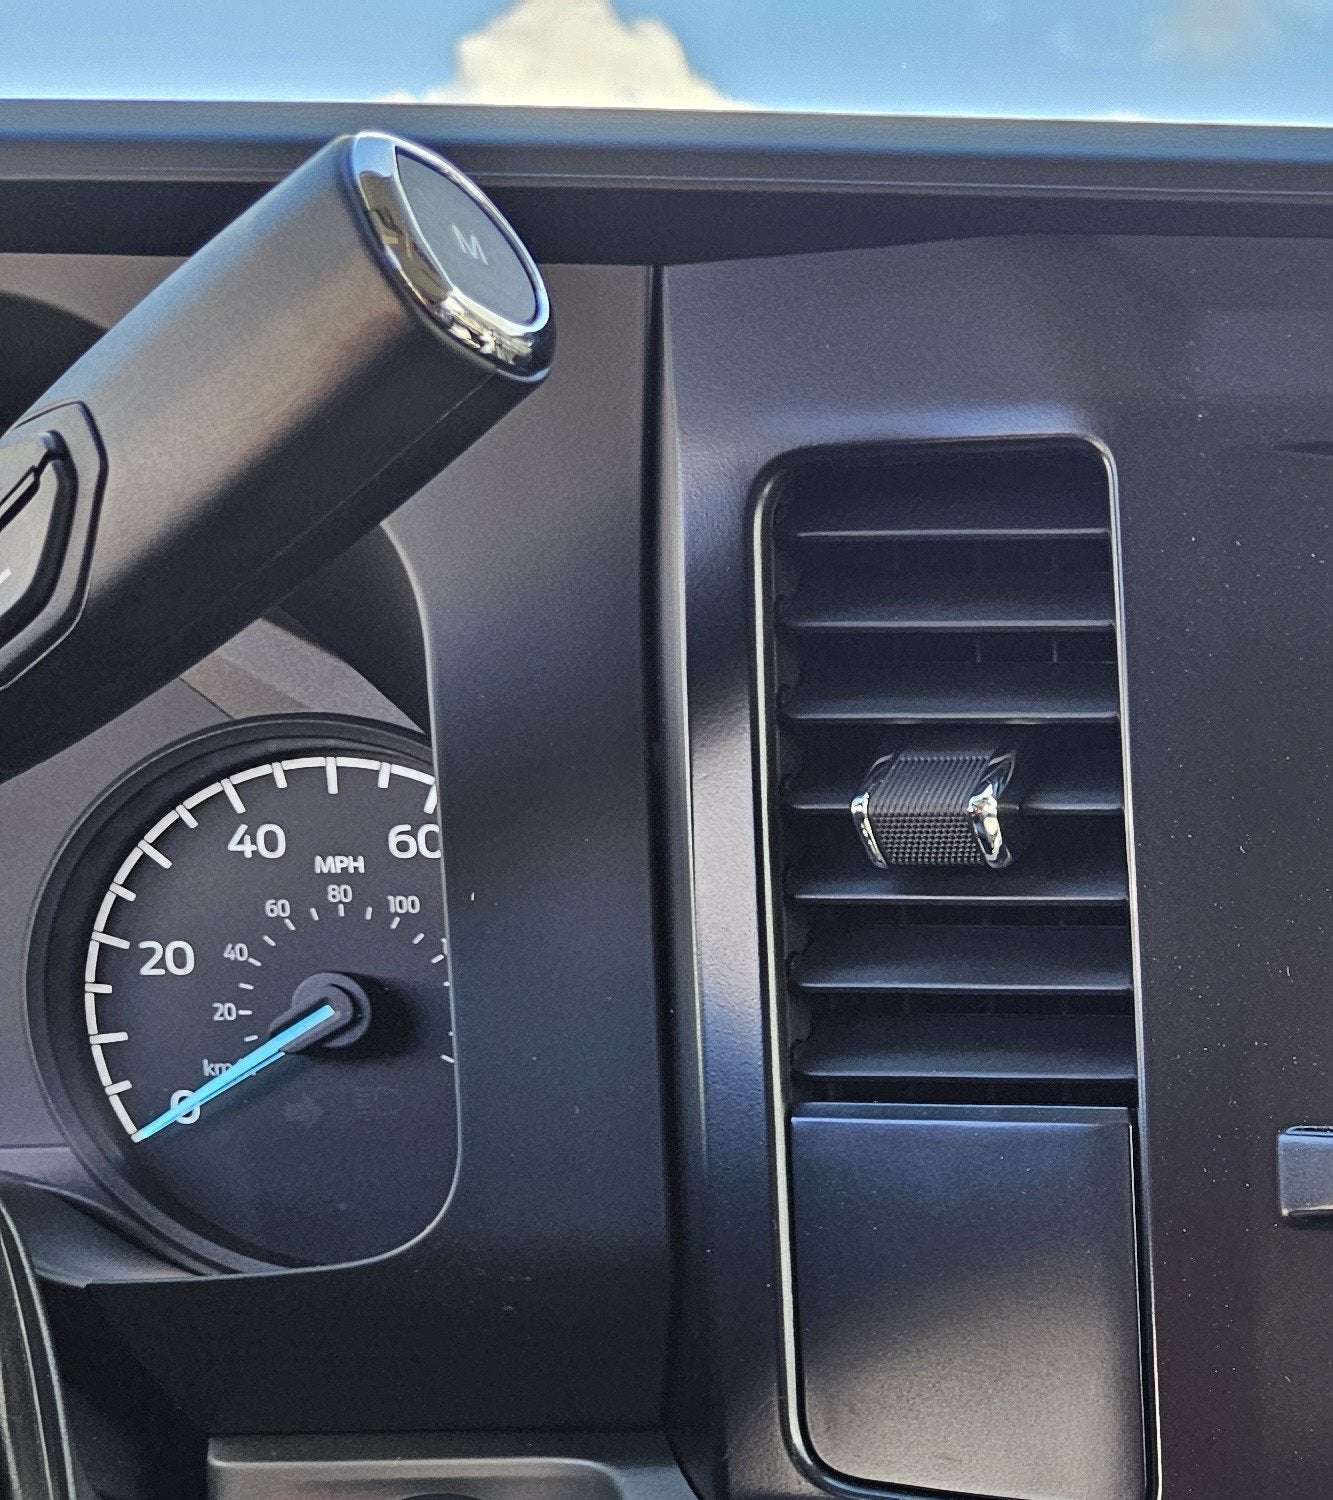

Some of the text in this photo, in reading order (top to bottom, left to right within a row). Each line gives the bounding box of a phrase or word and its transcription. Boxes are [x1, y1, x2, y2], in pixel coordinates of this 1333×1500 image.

[227, 823, 287, 860] 40
[387, 823, 441, 860] 60
[314, 855, 366, 875] MPH
[326, 884, 353, 904] 80
[265, 900, 291, 919] 60
[387, 895, 420, 915] 100
[138, 940, 196, 976] 20
[223, 943, 249, 963] 40
[213, 1003, 238, 1023] 20
